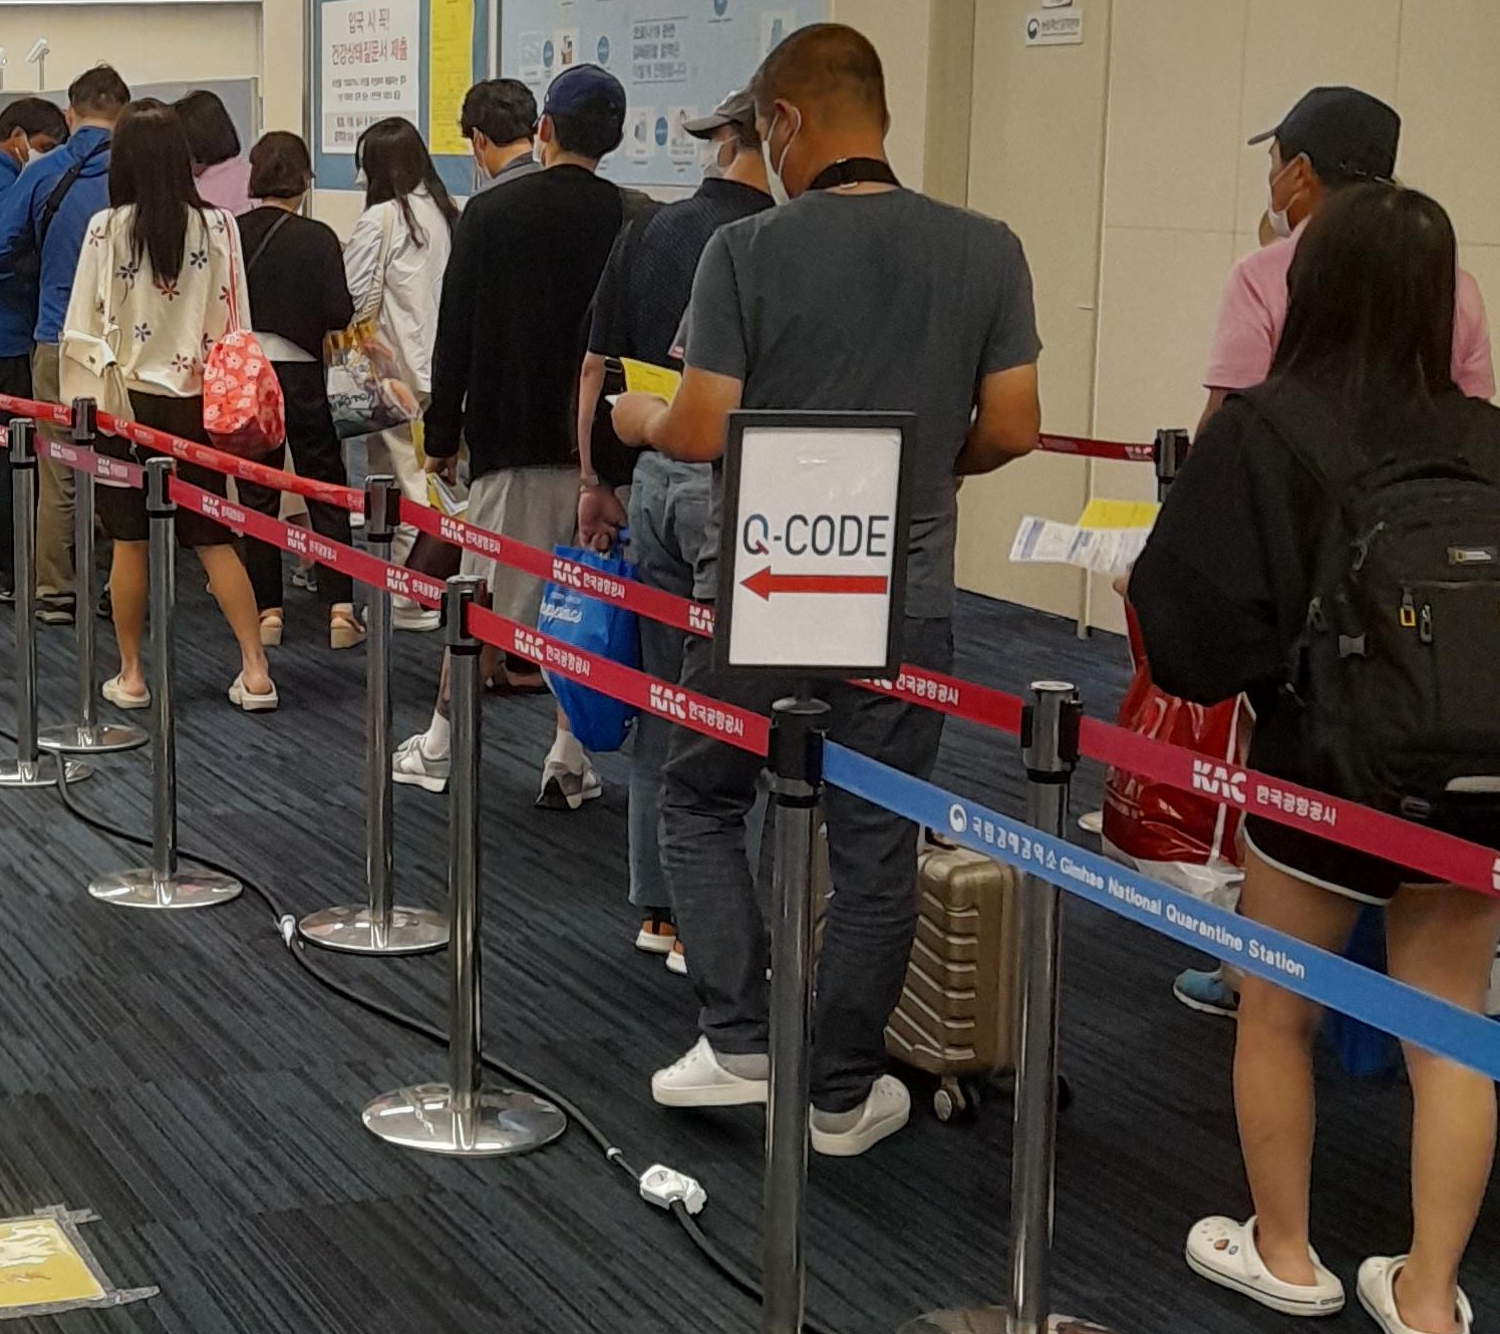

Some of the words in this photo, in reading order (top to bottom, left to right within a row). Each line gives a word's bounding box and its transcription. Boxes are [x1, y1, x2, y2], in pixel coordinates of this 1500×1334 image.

[743, 513, 889, 557] Q-CODE
[649, 683, 686, 720] KAC
[1192, 759, 1248, 803] KAC
[1108, 876, 1162, 916] National
[1166, 903, 1243, 952] Quarantine
[1248, 939, 1306, 979] Station
